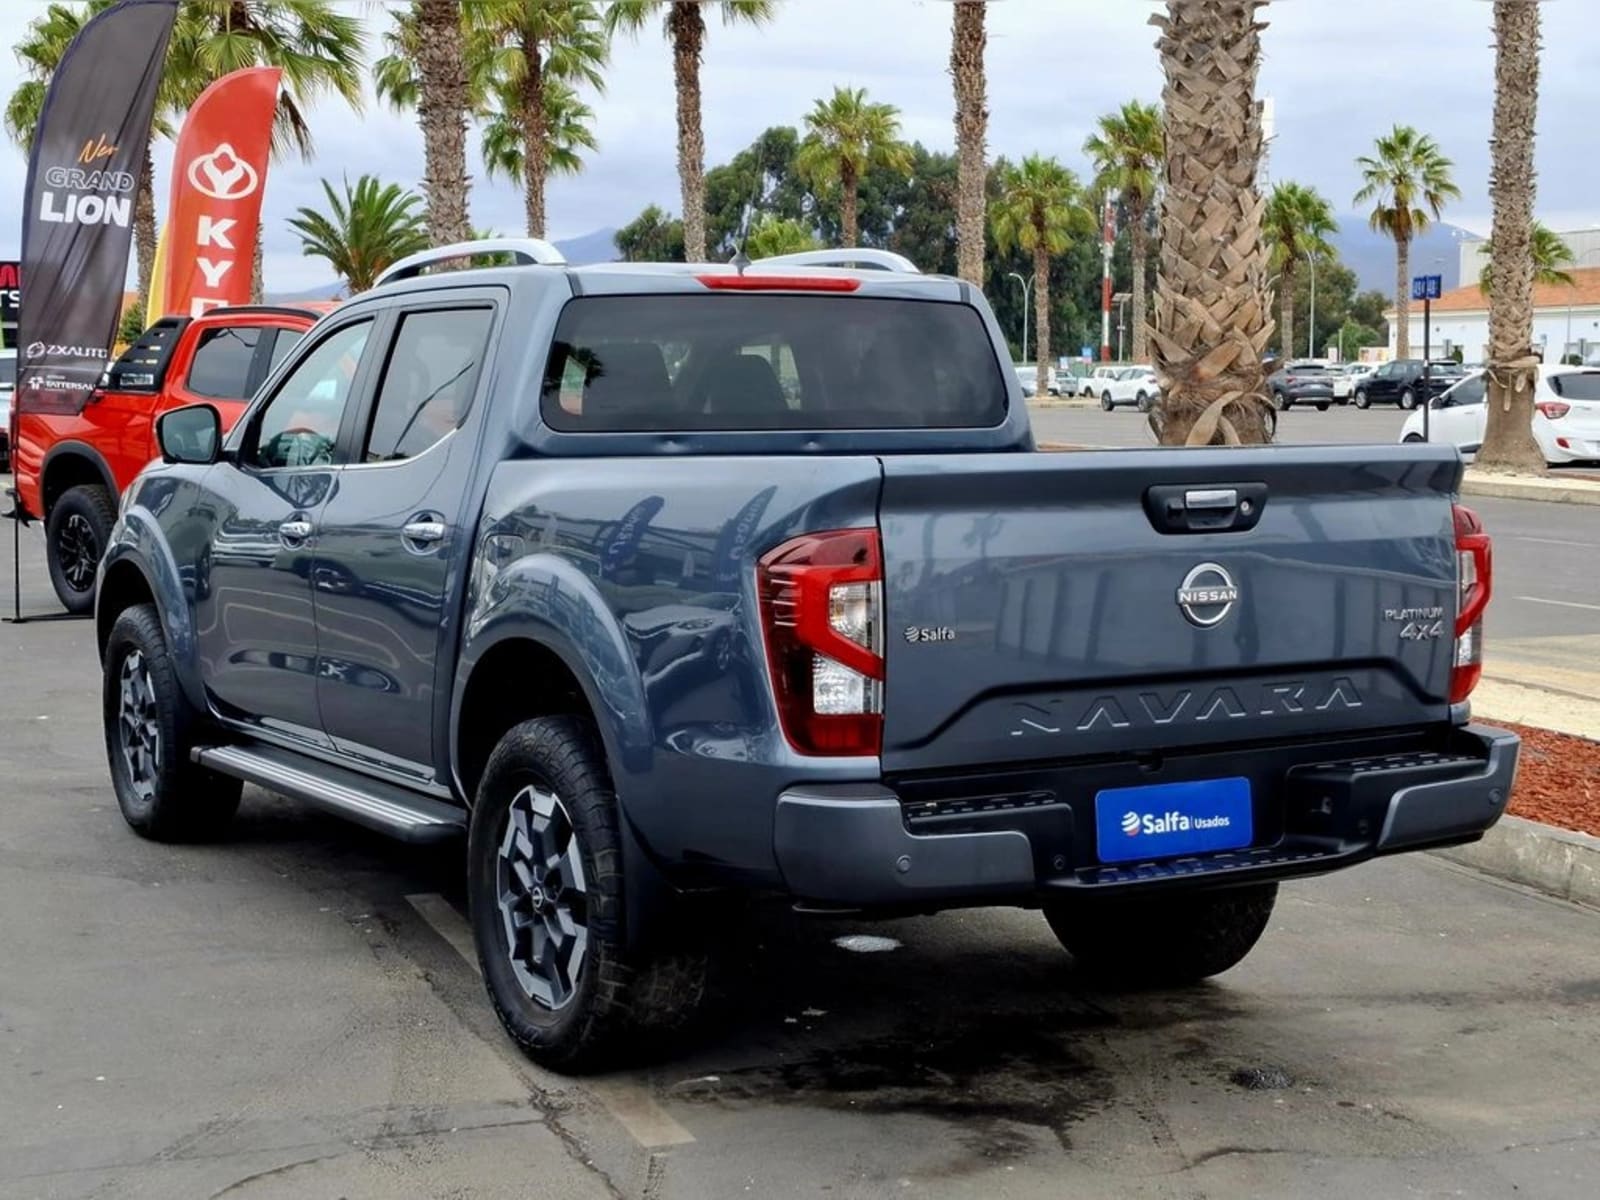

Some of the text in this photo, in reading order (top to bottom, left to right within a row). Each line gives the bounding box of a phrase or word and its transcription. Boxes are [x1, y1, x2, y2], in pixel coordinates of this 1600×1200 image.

[45, 166, 134, 192] GRAND
[40, 191, 131, 227] LION
[1179, 589, 1238, 602] NISSAN
[1384, 606, 1444, 621] PLATINUM
[921, 626, 955, 641] Salfa
[1011, 676, 1362, 735] NAVARA
[1142, 811, 1230, 835] Salfa Usados
